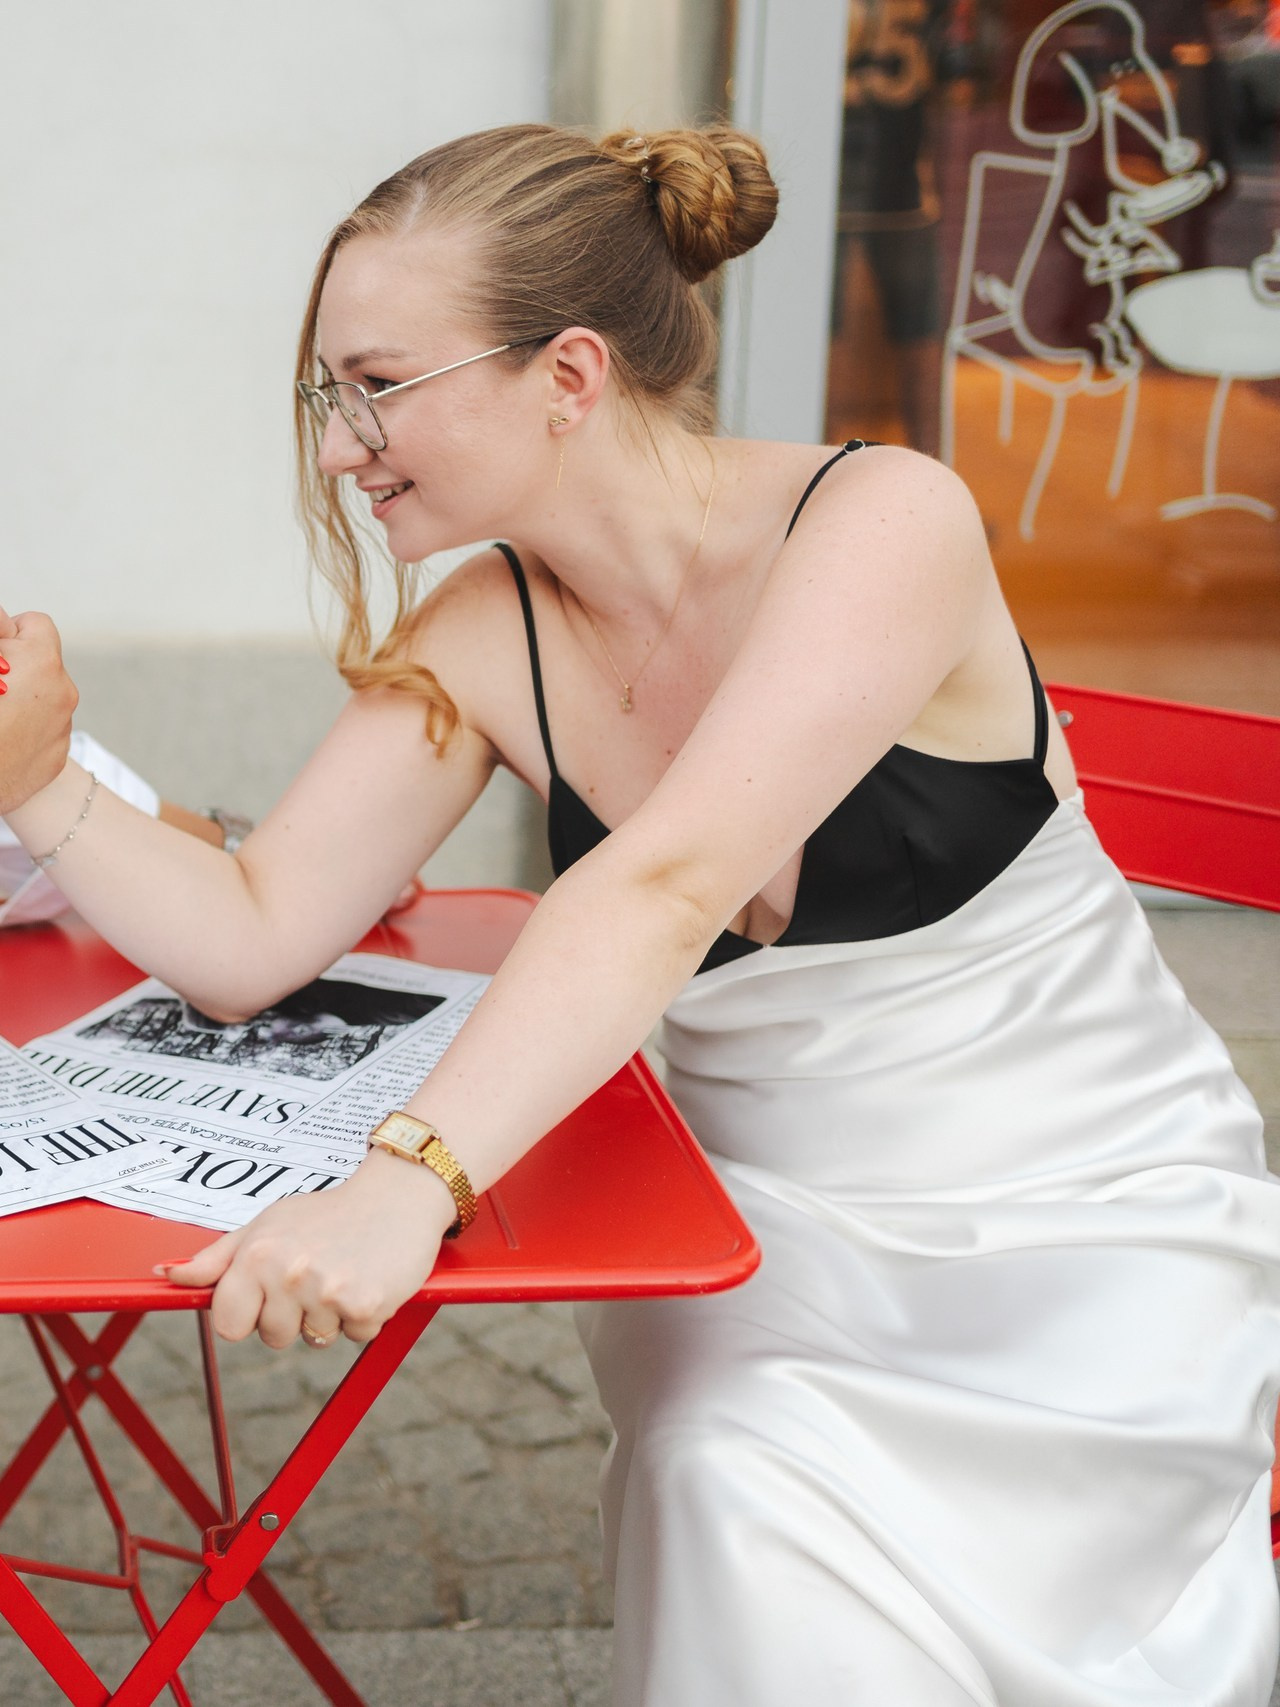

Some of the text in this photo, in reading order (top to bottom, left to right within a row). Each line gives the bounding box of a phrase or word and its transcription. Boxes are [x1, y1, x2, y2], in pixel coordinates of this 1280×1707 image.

[98, 1070, 186, 1101] THE
[178, 1084, 309, 1124] SAVE
[0, 1117, 47, 1129] 15/05
[313, 1123, 368, 1136] Alexandra
[24, 1118, 148, 1165] THE
[159, 1141, 294, 1198] LOV
